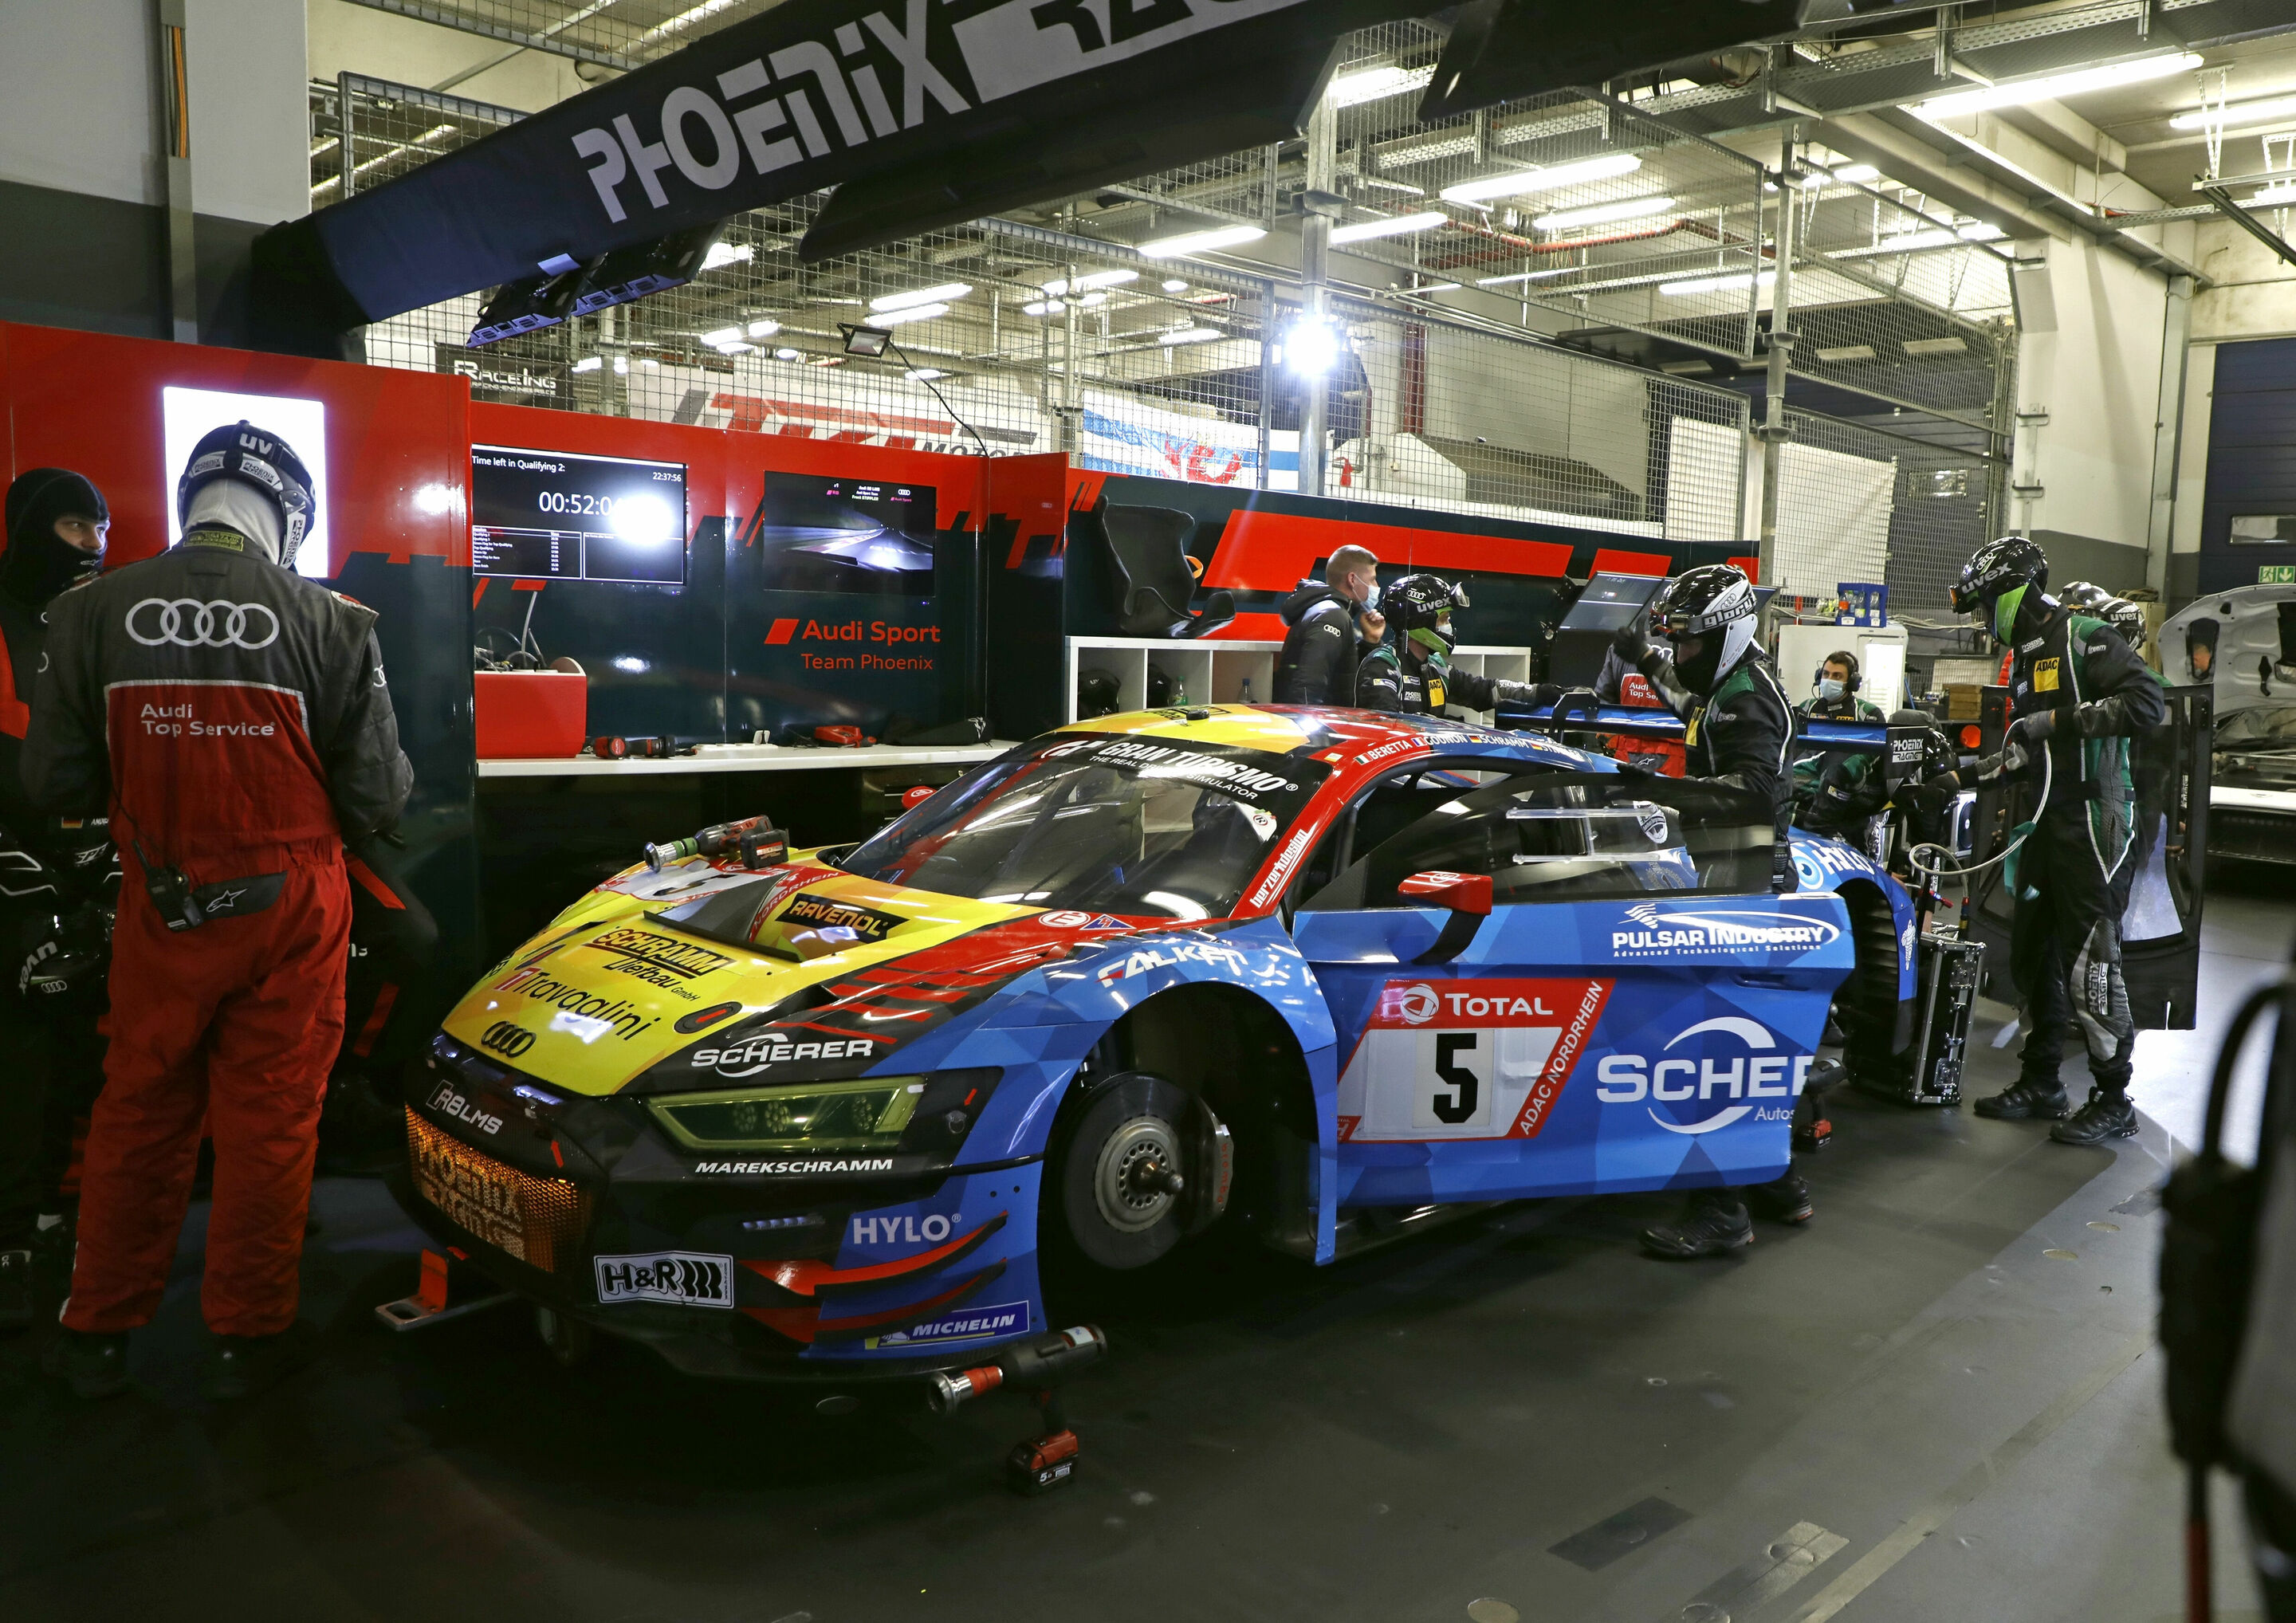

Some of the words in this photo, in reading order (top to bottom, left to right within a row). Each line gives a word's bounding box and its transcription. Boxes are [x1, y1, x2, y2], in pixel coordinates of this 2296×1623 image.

[572, 0, 971, 223] PHOENIX
[244, 461, 275, 481] PHOENIX
[472, 455, 492, 466] Time
[493, 458, 507, 467] left
[517, 459, 556, 473] Qualifying
[558, 463, 565, 472] 2:
[652, 471, 682, 481] 22:37:56
[539, 491, 615, 517] 00:52:0
[286, 518, 304, 564] PHOENIX
[1961, 562, 2012, 594] uvex
[1417, 596, 1452, 613] uvex
[2109, 611, 2137, 622] uvex
[801, 619, 863, 640] Audi
[871, 621, 941, 646] Sport
[800, 653, 854, 670] Team
[861, 654, 934, 670] Phoenix
[2035, 659, 2058, 672] ADAC
[1629, 682, 1649, 691] Audi
[140, 703, 193, 718] Audi
[141, 720, 183, 737] Top
[189, 721, 274, 737] Service
[1098, 741, 1172, 762] GRAN
[1367, 740, 1413, 760] BERETTA
[1480, 734, 1529, 749] SCHRAMM
[1893, 738, 1924, 752] PHOENIX
[1089, 756, 1114, 765] THE
[1115, 759, 1138, 768] REAL
[1248, 828, 1309, 909] berzerkdesign
[1810, 846, 1875, 875] HYLO
[753, 871, 839, 928] NORDRHEIN
[789, 900, 883, 937] RAVENOL
[1612, 929, 1705, 949] PULSAR
[1707, 925, 1825, 946] INDUSTRY
[592, 928, 736, 977] SCHRAMM
[1614, 949, 1669, 957] Advanced
[1677, 945, 1759, 955] Technological
[603, 956, 682, 989] Tiefbau
[1095, 944, 1249, 988] FALKEN
[671, 986, 701, 1002] GmbH
[2088, 961, 2100, 1014] PHOENIX
[512, 971, 662, 1041] Travaglini
[1445, 992, 1554, 1017] TOTAL
[1547, 980, 1604, 1085] NORDRHEIN
[690, 1039, 874, 1067] SCHERER
[1433, 1032, 1479, 1124] 5
[1520, 1083, 1554, 1136] ADAC
[694, 1158, 894, 1174] MAREKSCHRAMM
[602, 1258, 683, 1297] H&R
[912, 1314, 1016, 1337] MICHELIN
